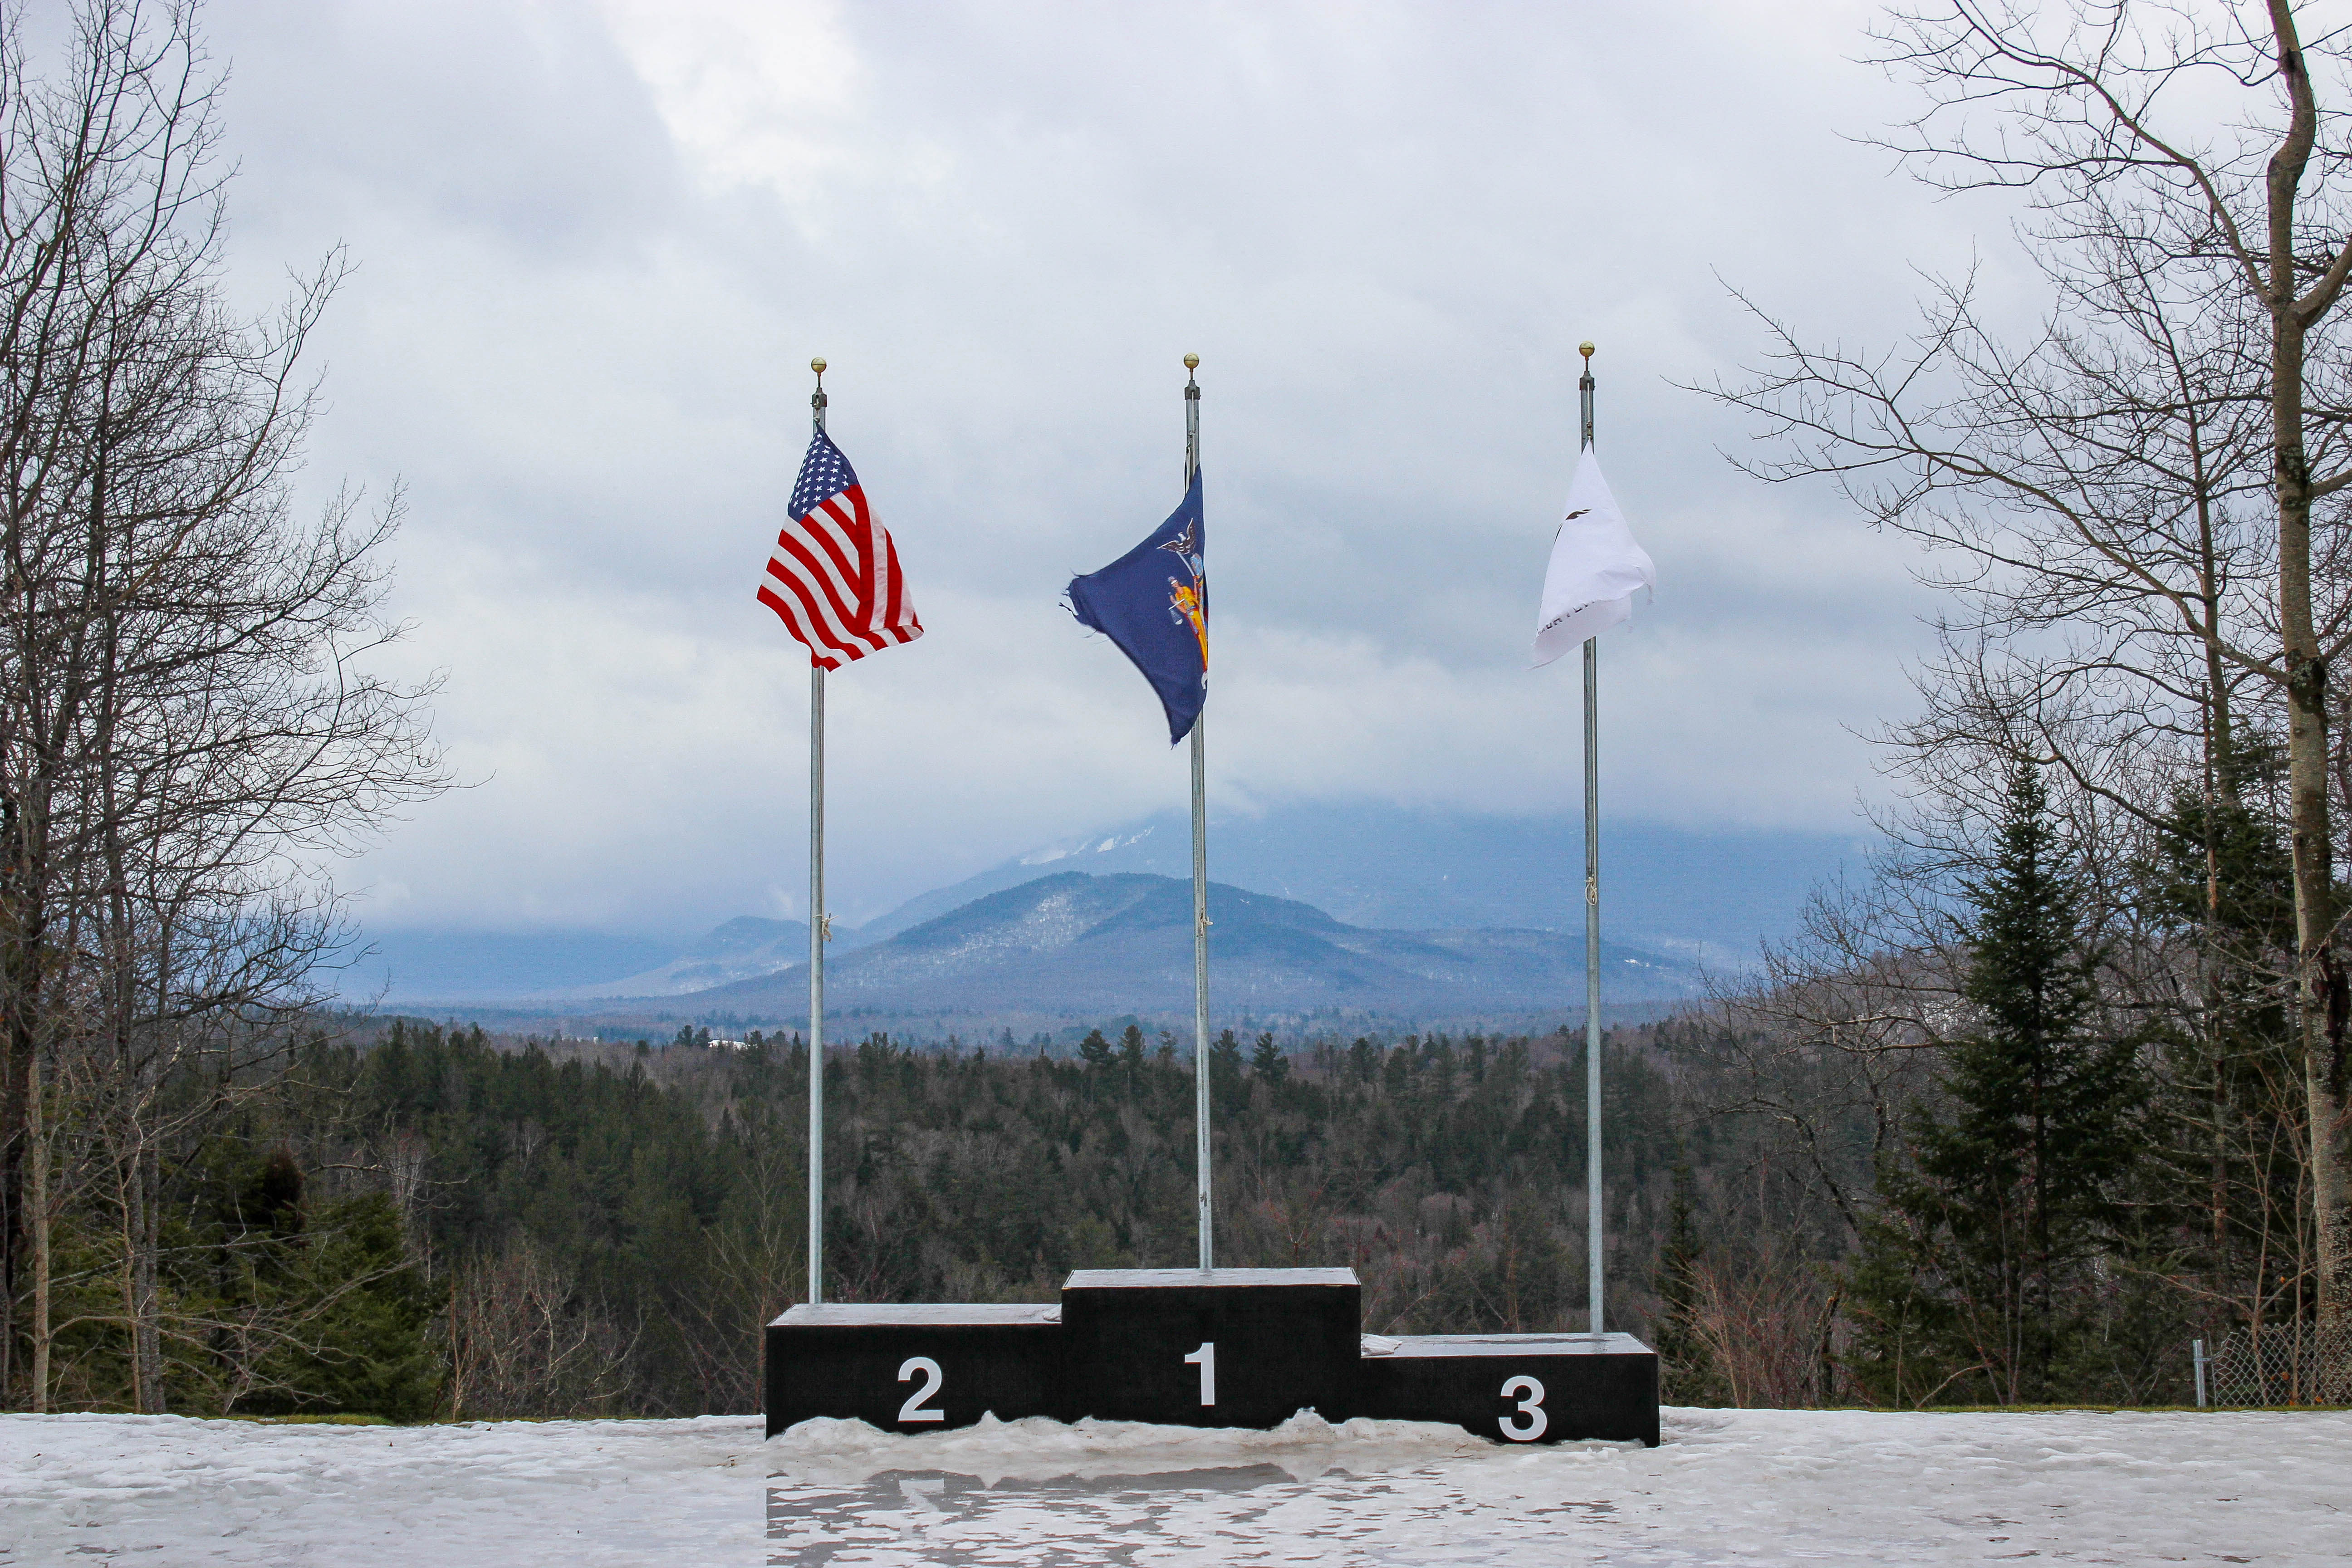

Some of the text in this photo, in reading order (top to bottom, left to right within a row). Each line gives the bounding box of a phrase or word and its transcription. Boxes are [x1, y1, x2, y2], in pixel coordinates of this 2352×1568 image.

[898, 1357, 944, 1421] 2
[1184, 1343, 1215, 1406] 1
[1498, 1376, 1547, 1441] 3
